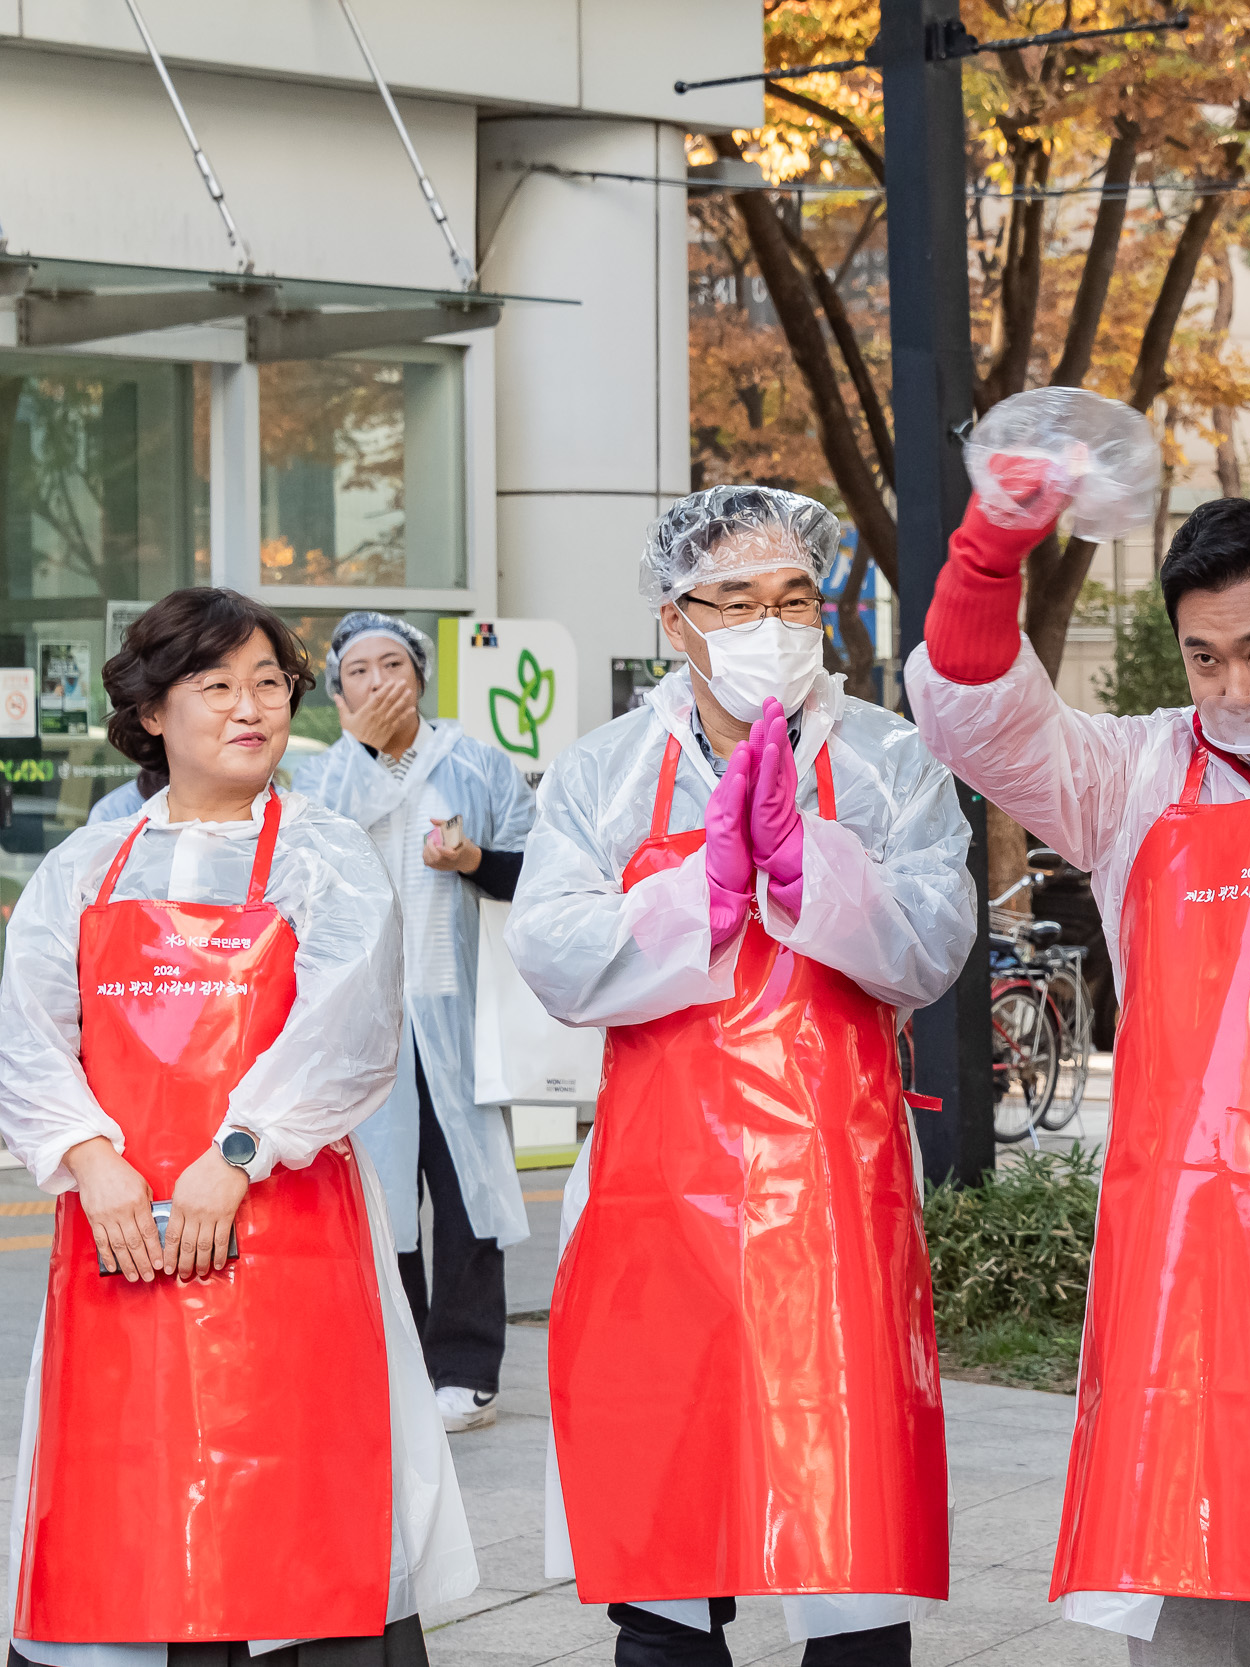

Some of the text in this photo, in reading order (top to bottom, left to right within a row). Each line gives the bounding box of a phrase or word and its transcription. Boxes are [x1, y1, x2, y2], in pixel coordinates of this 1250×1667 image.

[1183, 889, 1215, 903] 제2회
[1217, 884, 1239, 902] 광진
[153, 965, 180, 976] 2024
[96, 982, 125, 996] 제2회
[128, 980, 154, 996] 광진
[155, 980, 196, 996] 사랑의
